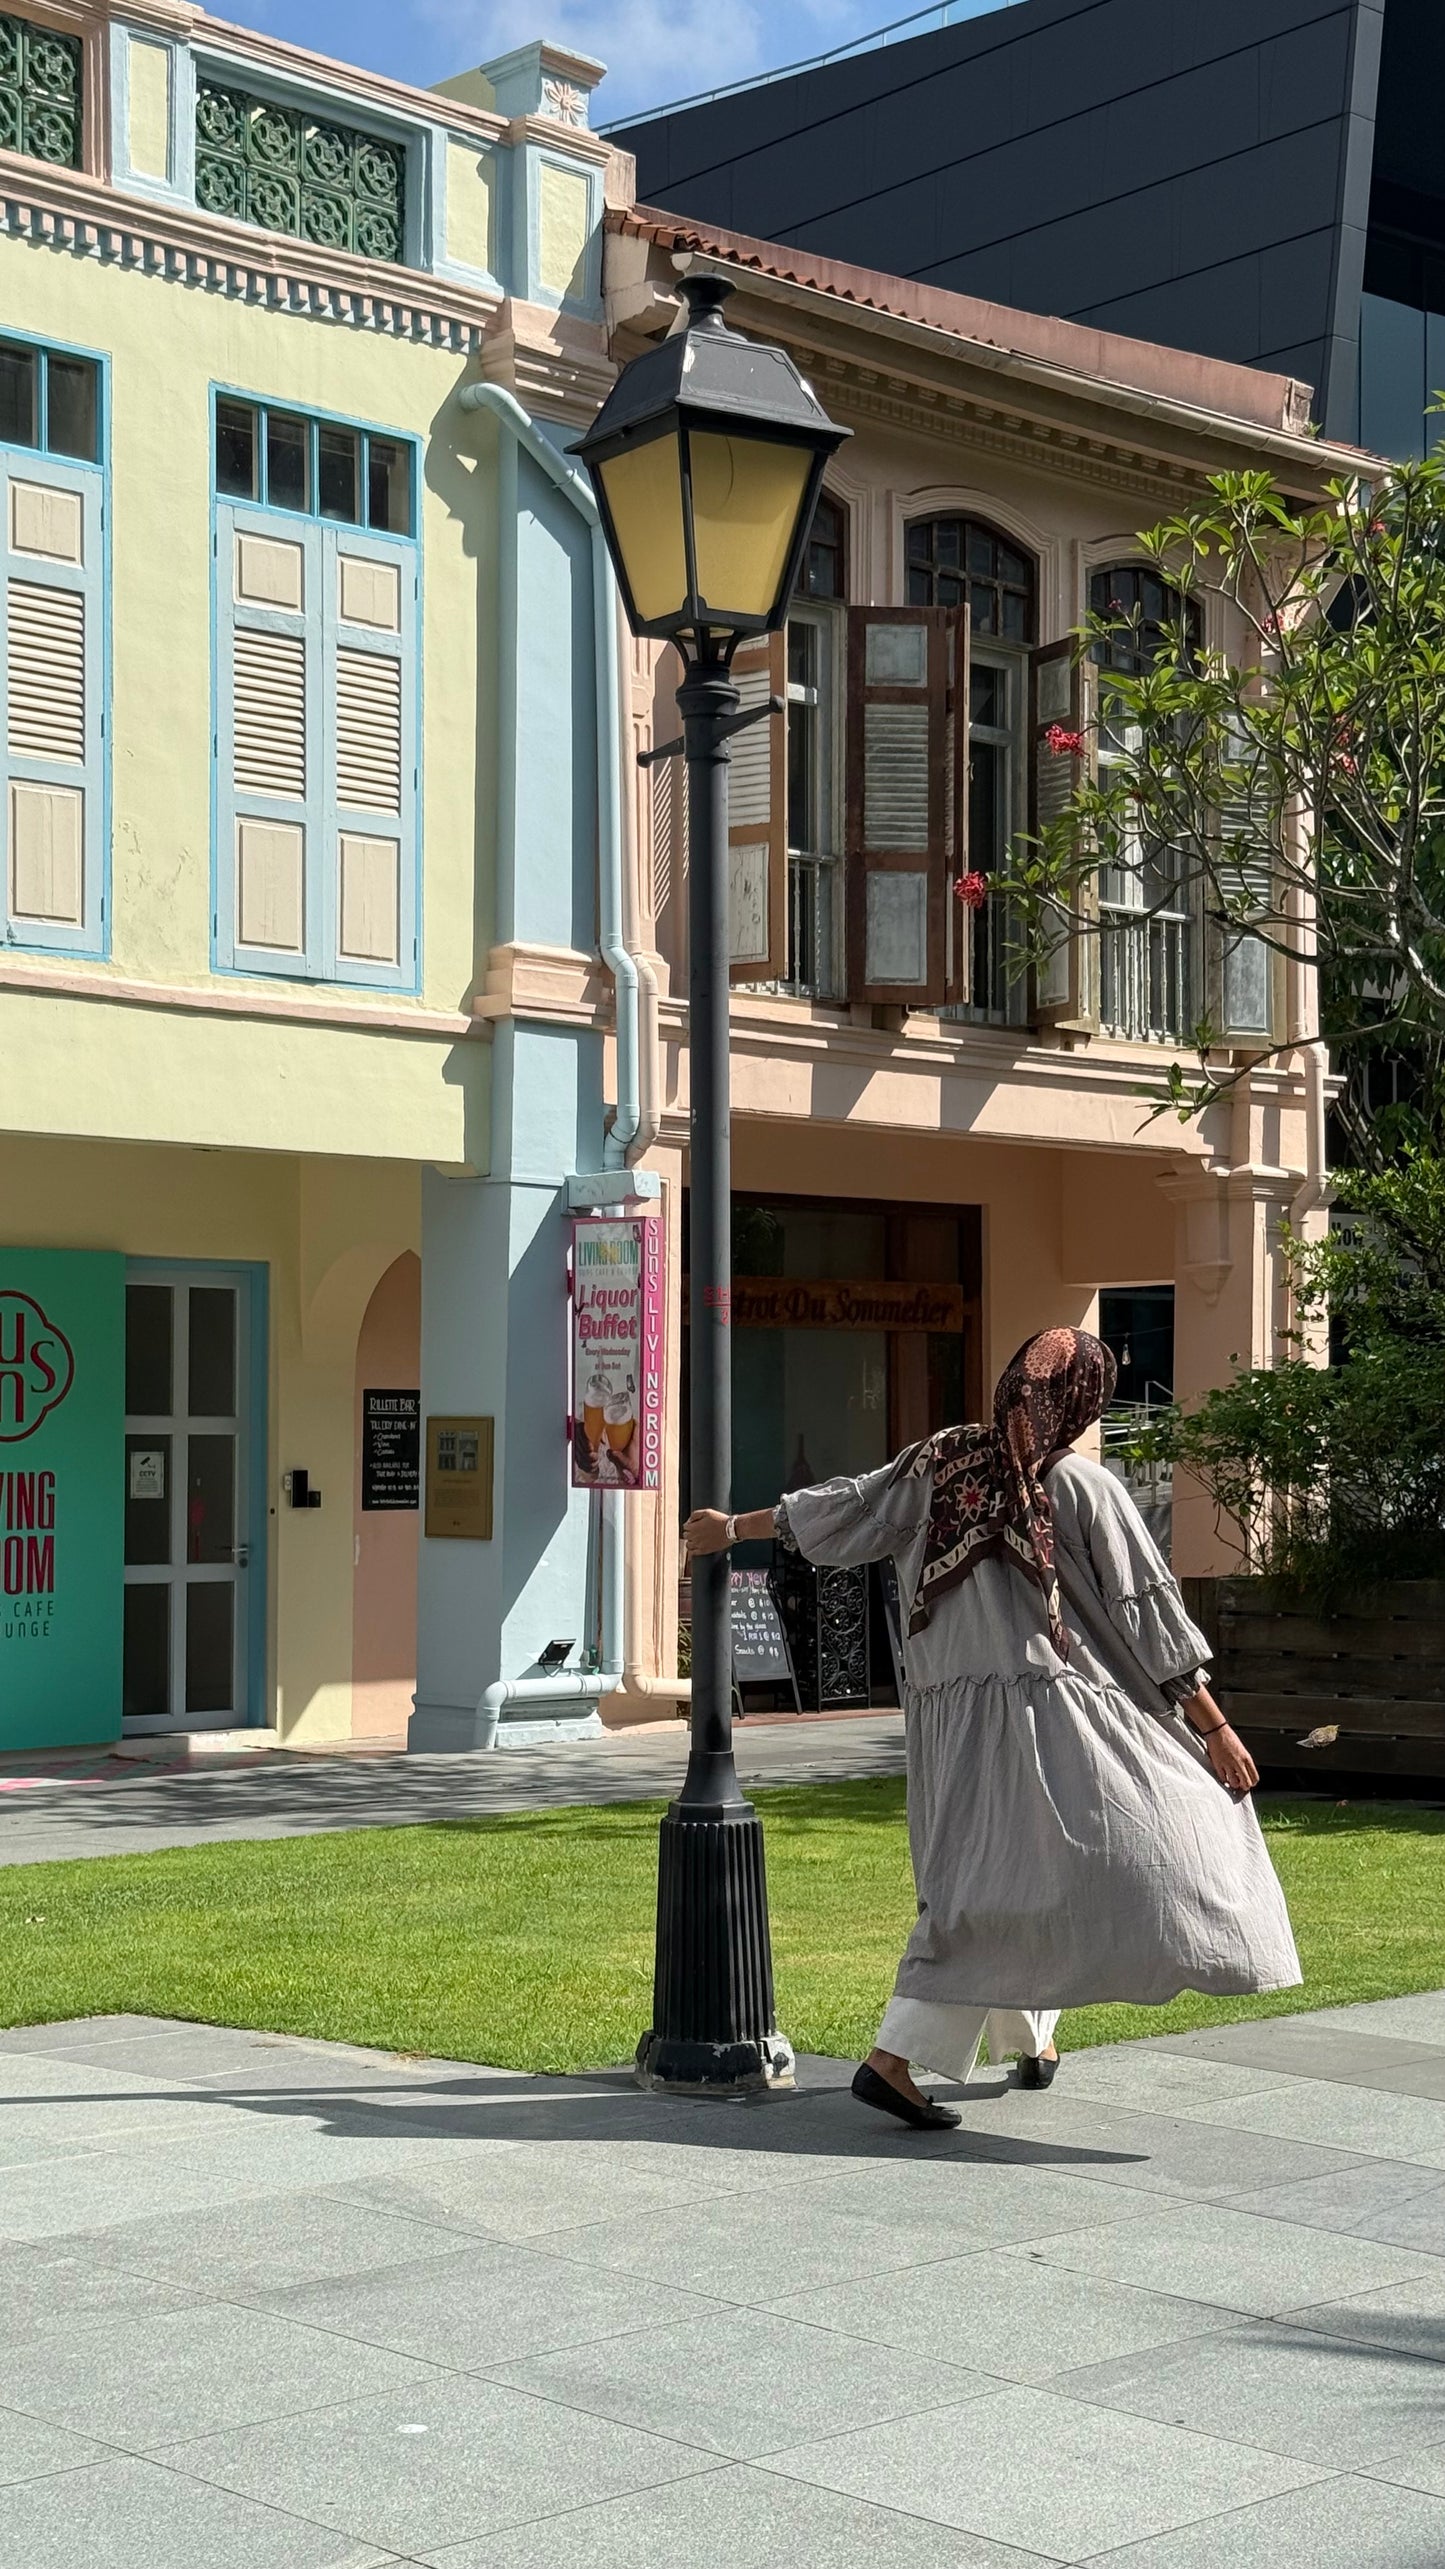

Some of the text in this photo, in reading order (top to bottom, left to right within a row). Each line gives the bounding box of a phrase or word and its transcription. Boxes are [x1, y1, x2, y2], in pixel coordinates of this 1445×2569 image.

[579, 1240, 608, 1266] LIVING
[579, 1284, 639, 1314] Liquor
[785, 1288, 826, 1321] Du
[832, 1289, 954, 1326] Sommelier
[578, 1313, 638, 1339] Buffet
[646, 1297, 659, 1410] LIVING
[399, 1398, 415, 1412] BAR
[645, 1413, 659, 1488] ROOM
[0, 1471, 55, 1530] ING
[14, 1601, 54, 1618] CAFE
